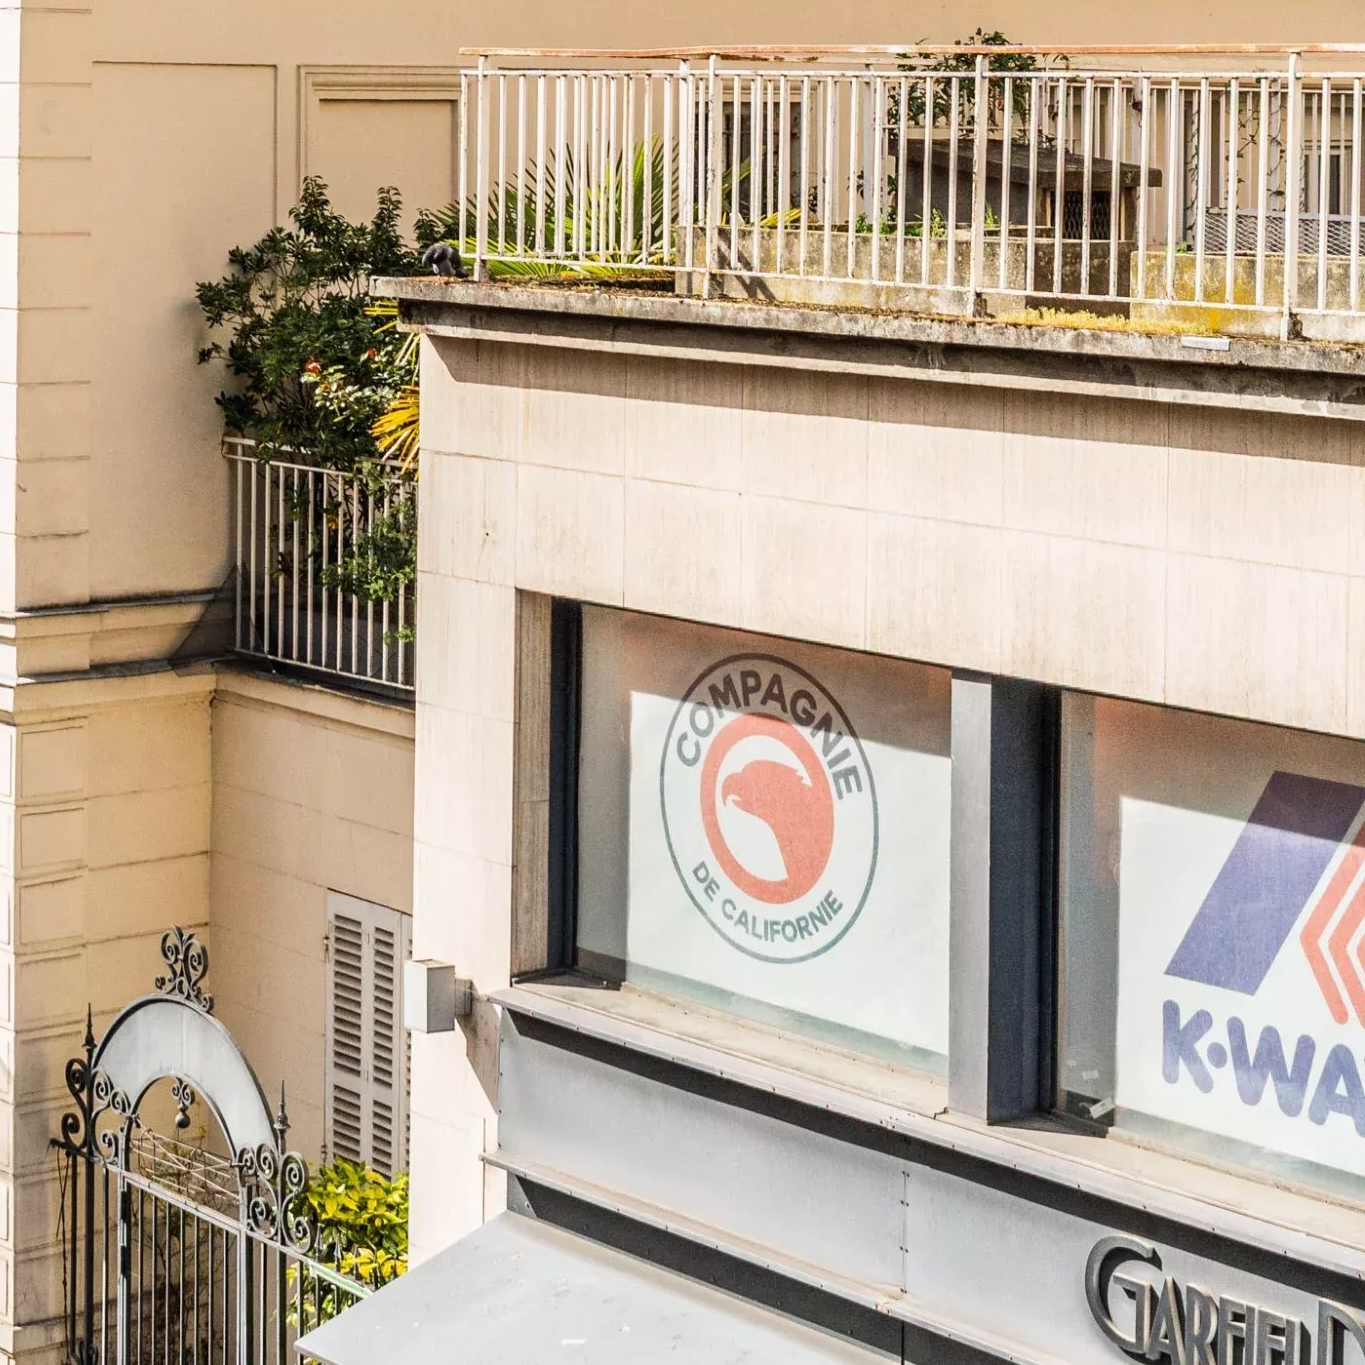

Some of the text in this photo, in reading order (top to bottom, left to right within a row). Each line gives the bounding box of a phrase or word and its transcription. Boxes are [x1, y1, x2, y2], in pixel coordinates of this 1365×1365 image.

[676, 669, 864, 801] COMPAGNIE
[691, 860, 843, 944] DE CALIFORNIE
